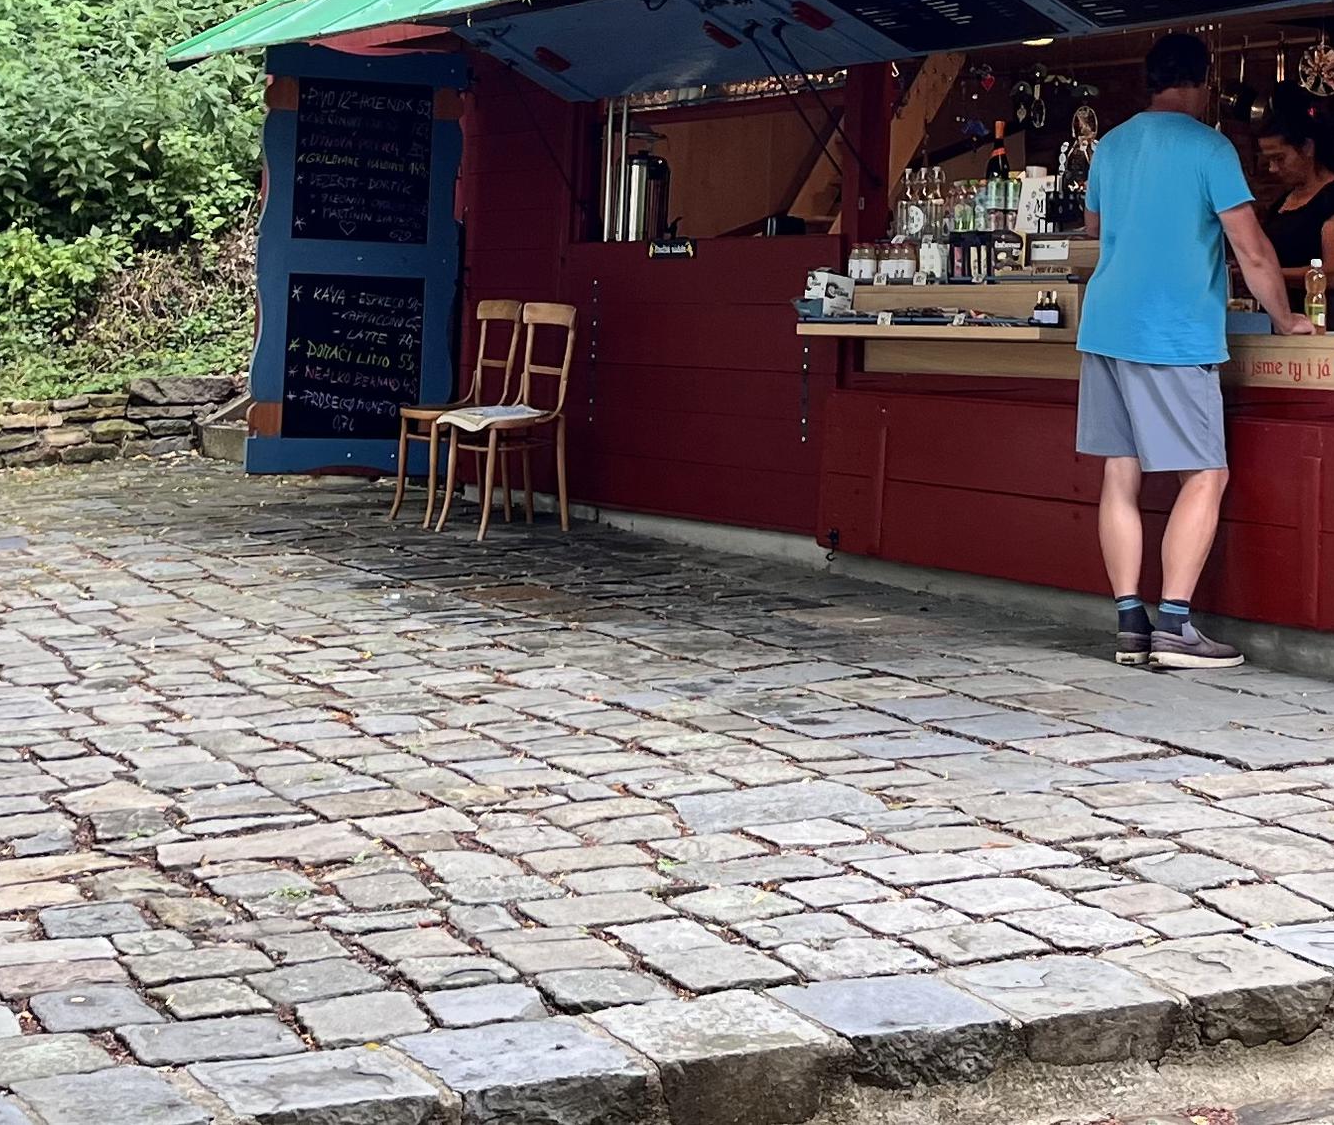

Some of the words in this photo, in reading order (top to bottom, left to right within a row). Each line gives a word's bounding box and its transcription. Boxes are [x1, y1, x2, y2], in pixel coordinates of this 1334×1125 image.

[314, 284, 346, 306] KÁVA
[347, 329, 388, 345] LATTE
[304, 365, 352, 384] NEALKO
[1251, 361, 1283, 377] jsme
[1288, 360, 1302, 382] ty
[1317, 357, 1331, 379] já
